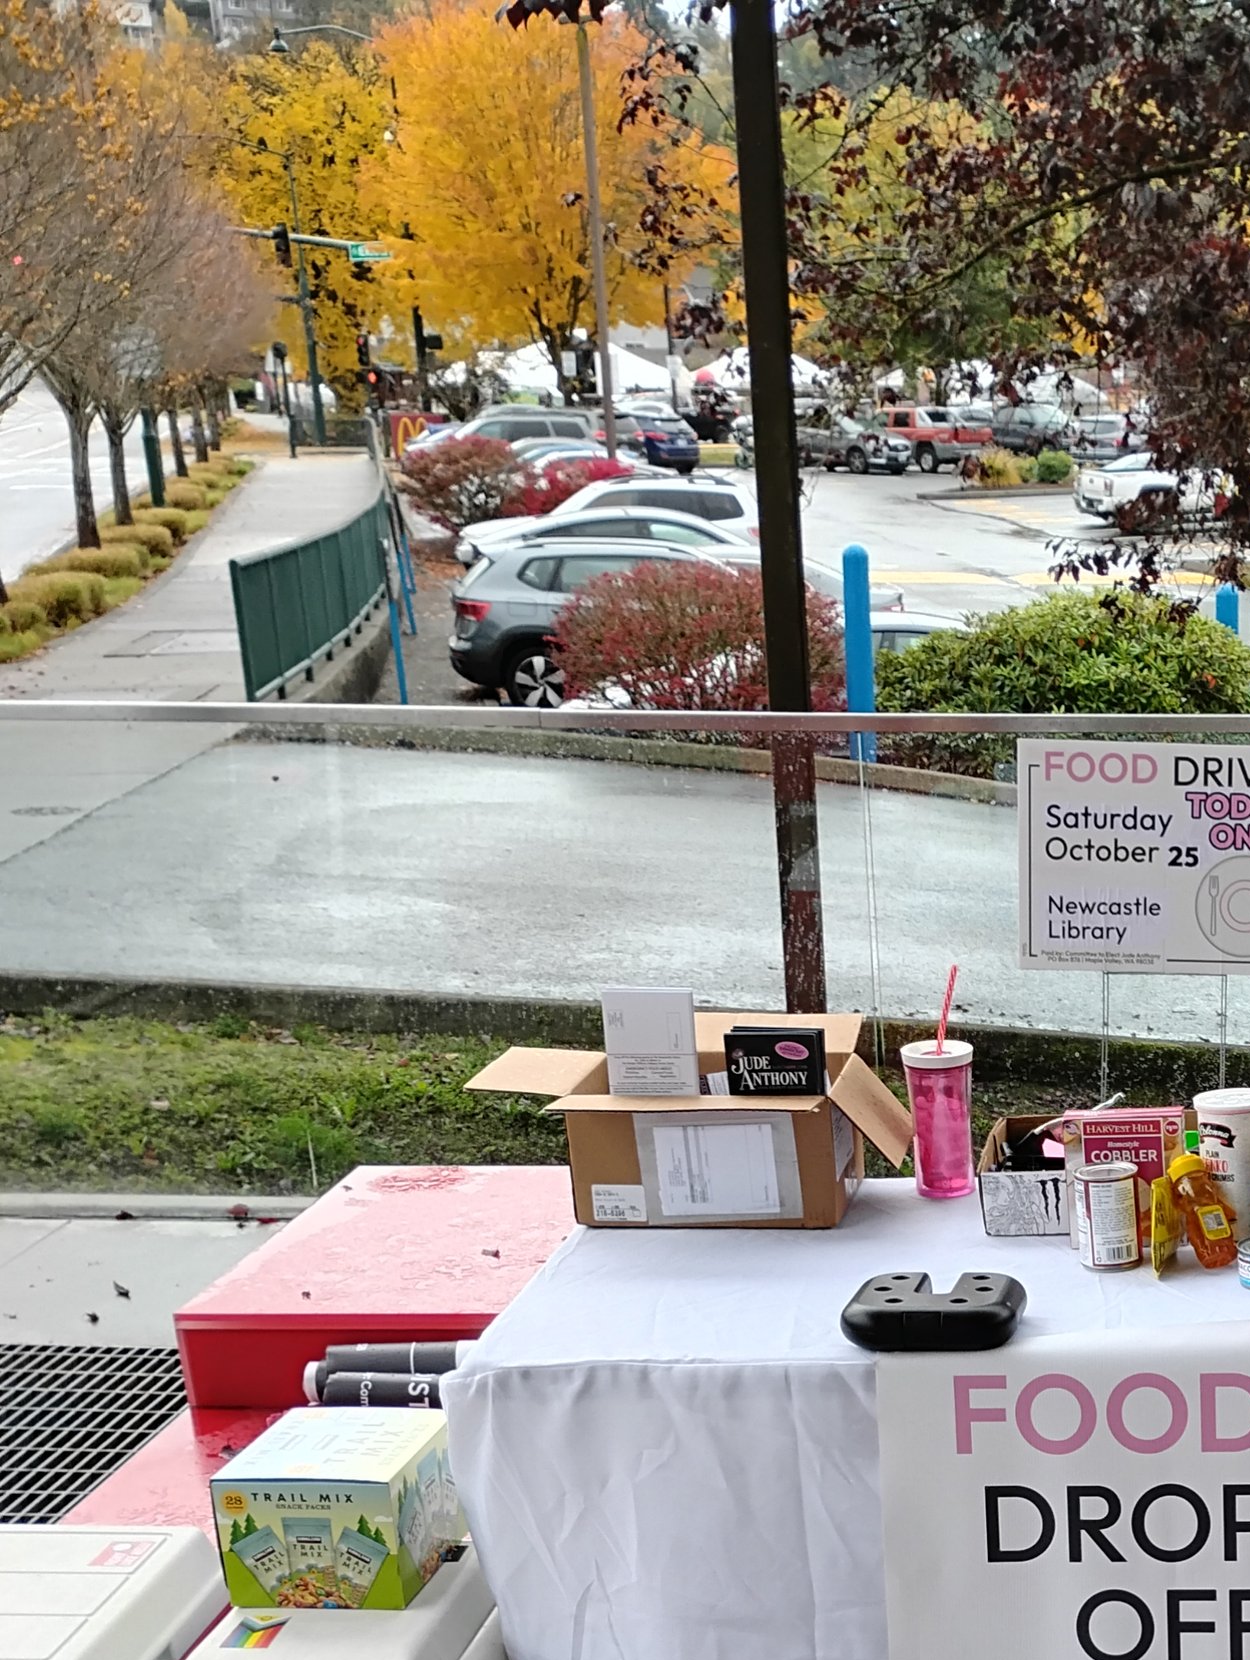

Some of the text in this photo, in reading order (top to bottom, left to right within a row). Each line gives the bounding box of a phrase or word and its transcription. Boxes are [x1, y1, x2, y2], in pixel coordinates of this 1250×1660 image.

[1044, 751, 1158, 784] FOOD
[1046, 804, 1173, 837] Saturday
[1045, 837, 1199, 867] October 25
[1048, 896, 1161, 916] Newcastle
[1048, 920, 1127, 944] Library
[731, 1056, 771, 1074] JUDE
[739, 1071, 808, 1090] ANTHONY
[1086, 1124, 1131, 1133] HARVEST
[1107, 1141, 1140, 1149] Homestyle
[1091, 1150, 1158, 1163] COBBLER
[251, 1493, 354, 1504] TRAIL MIX
[253, 1551, 286, 1571] TRAIL
[264, 1560, 284, 1574] MIX
[339, 1551, 373, 1574] TRAIL
[342, 1562, 364, 1576] MIX
